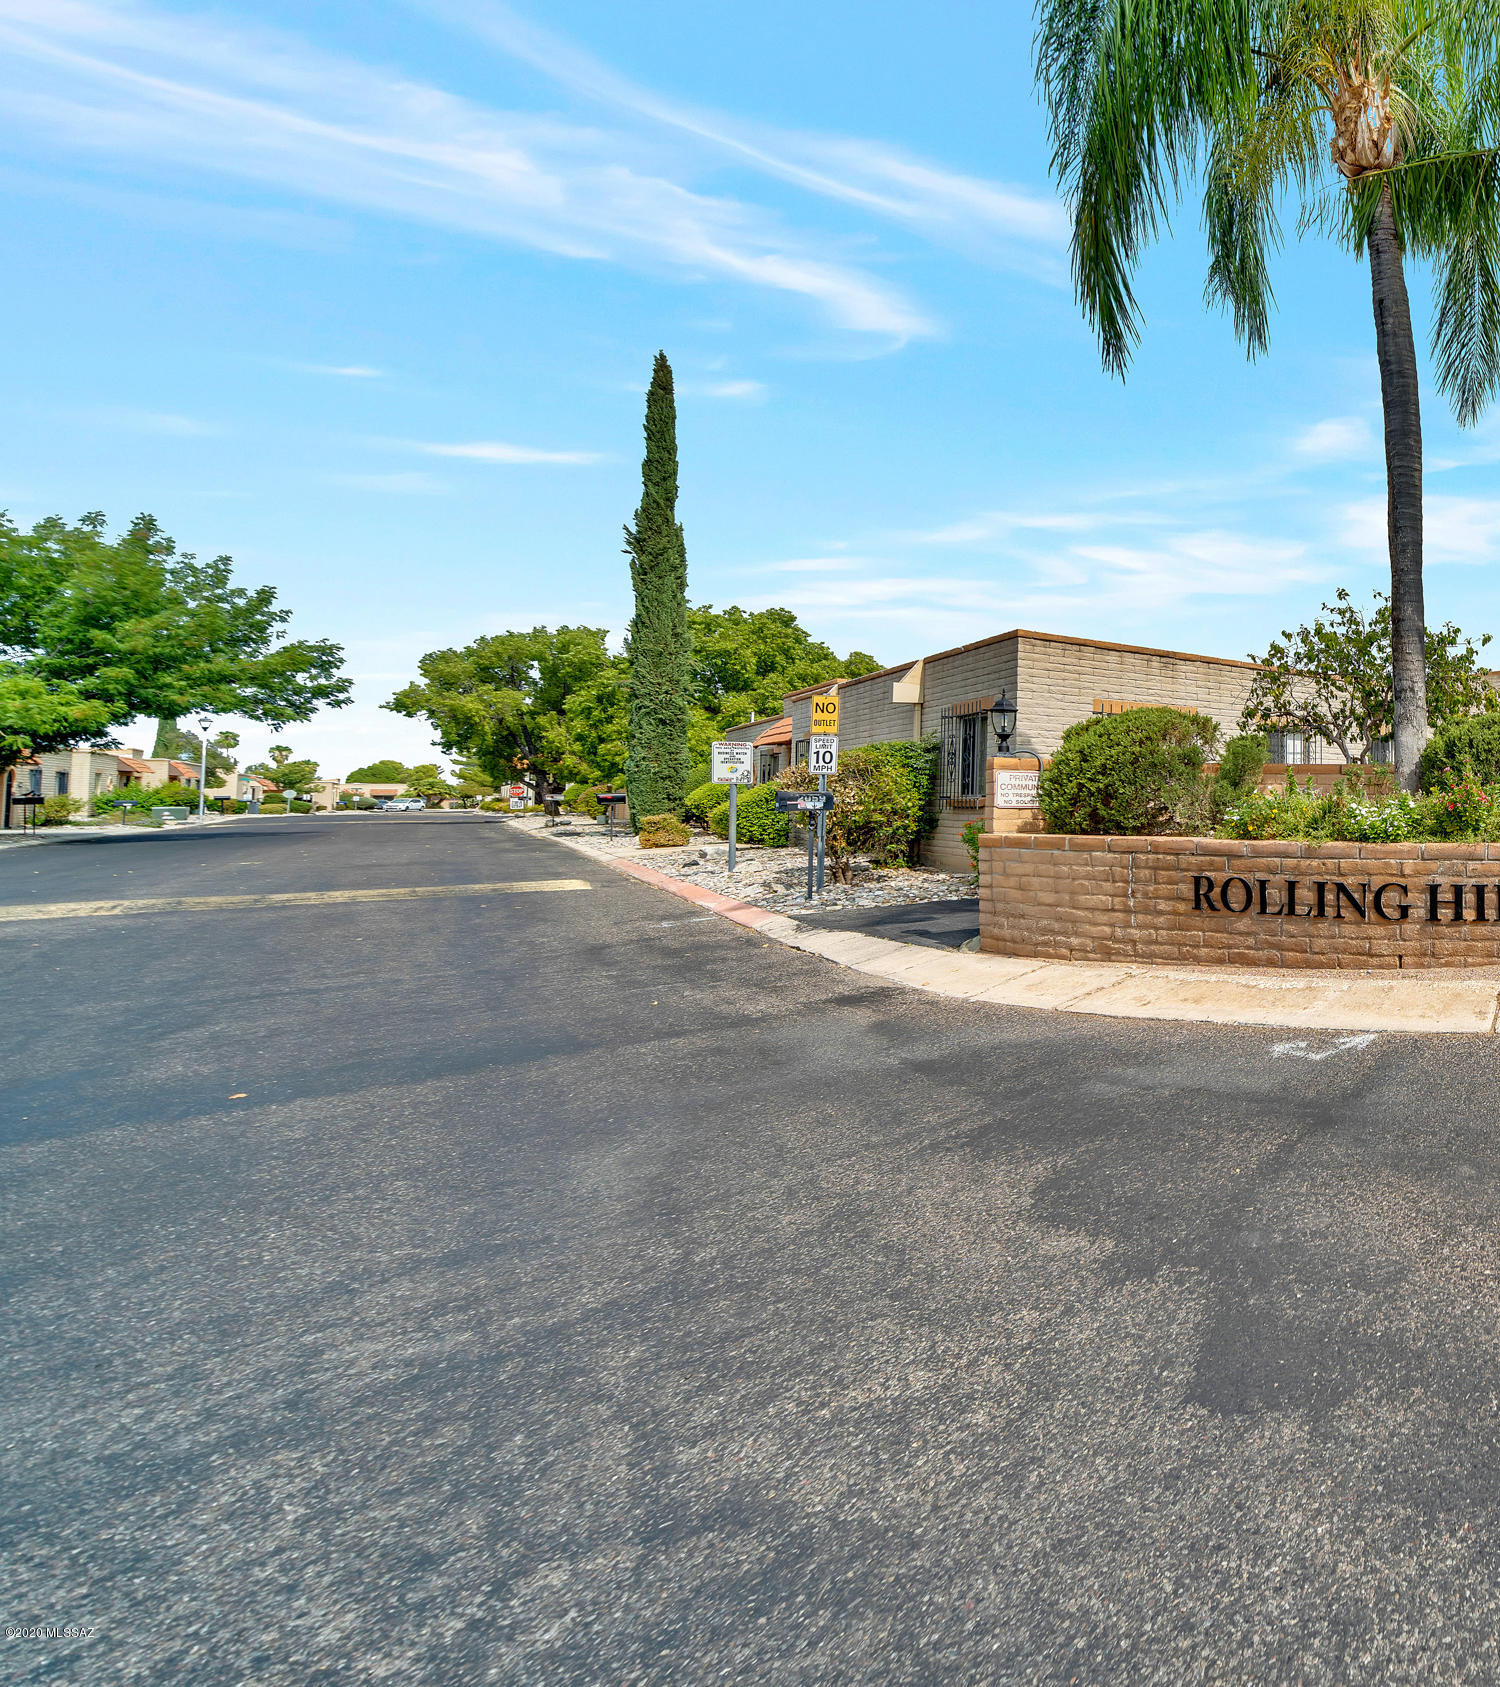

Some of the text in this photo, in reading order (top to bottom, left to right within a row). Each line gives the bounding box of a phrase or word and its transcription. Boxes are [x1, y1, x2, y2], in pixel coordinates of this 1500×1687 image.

[815, 703, 836, 714] NO
[814, 751, 833, 764] 10
[1191, 875, 1411, 921] ROLLING
